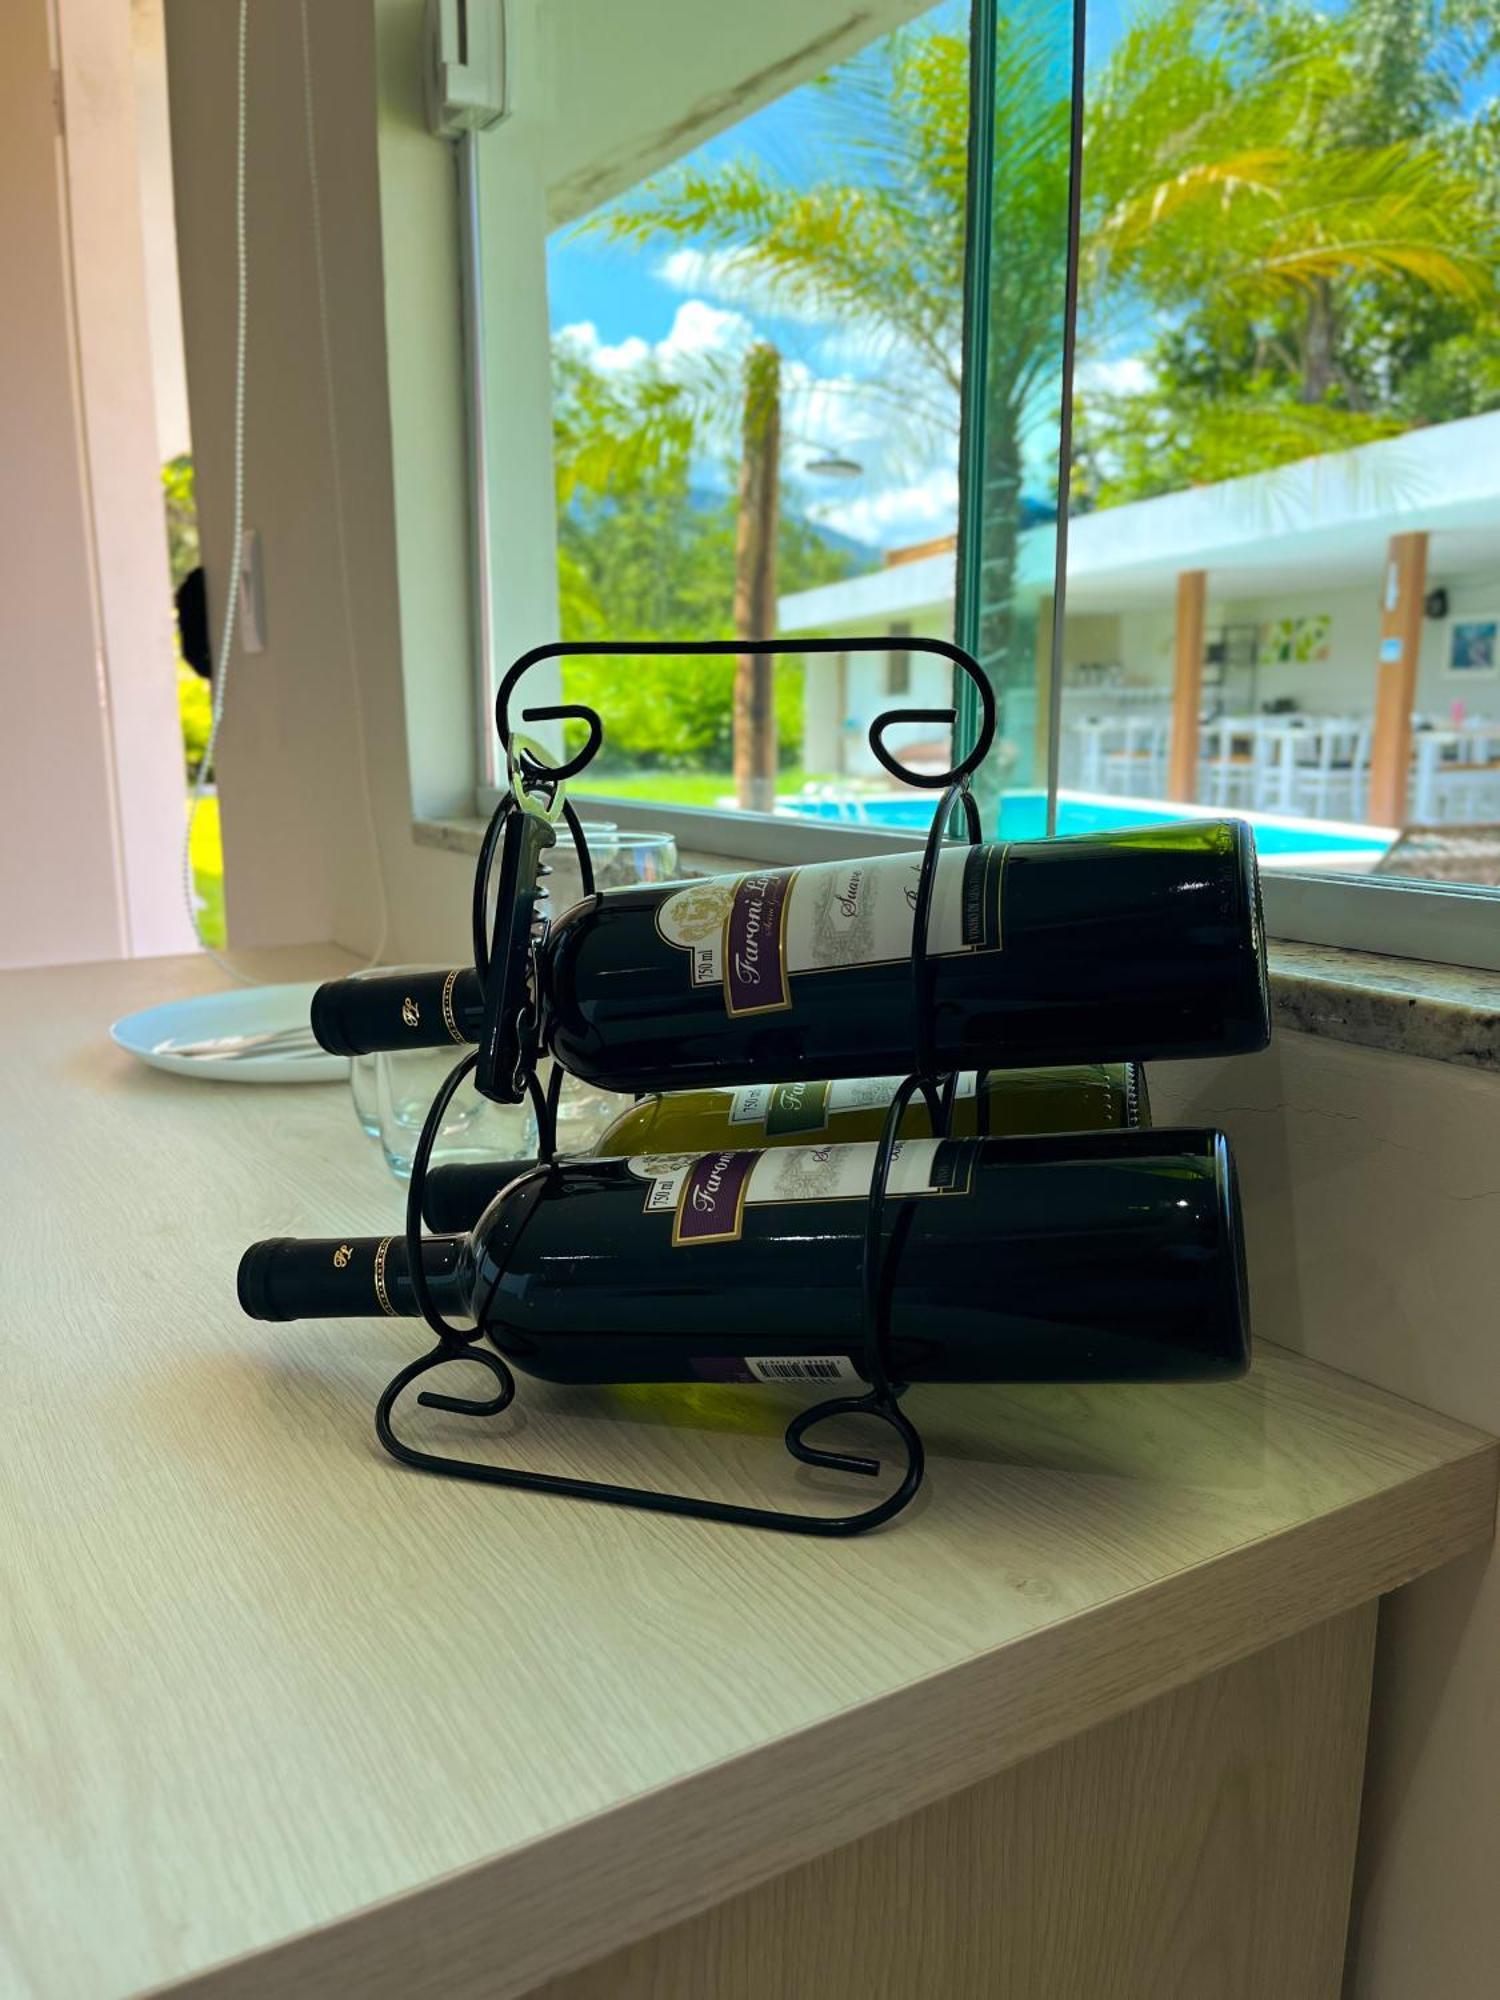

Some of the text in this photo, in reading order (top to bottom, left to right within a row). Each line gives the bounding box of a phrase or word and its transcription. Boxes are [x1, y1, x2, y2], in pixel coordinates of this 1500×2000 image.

[835, 870, 862, 919] Suave
[735, 900, 763, 984] Faroni
[698, 949, 713, 980] 750 ml
[653, 1180, 674, 1206] 750 ml
